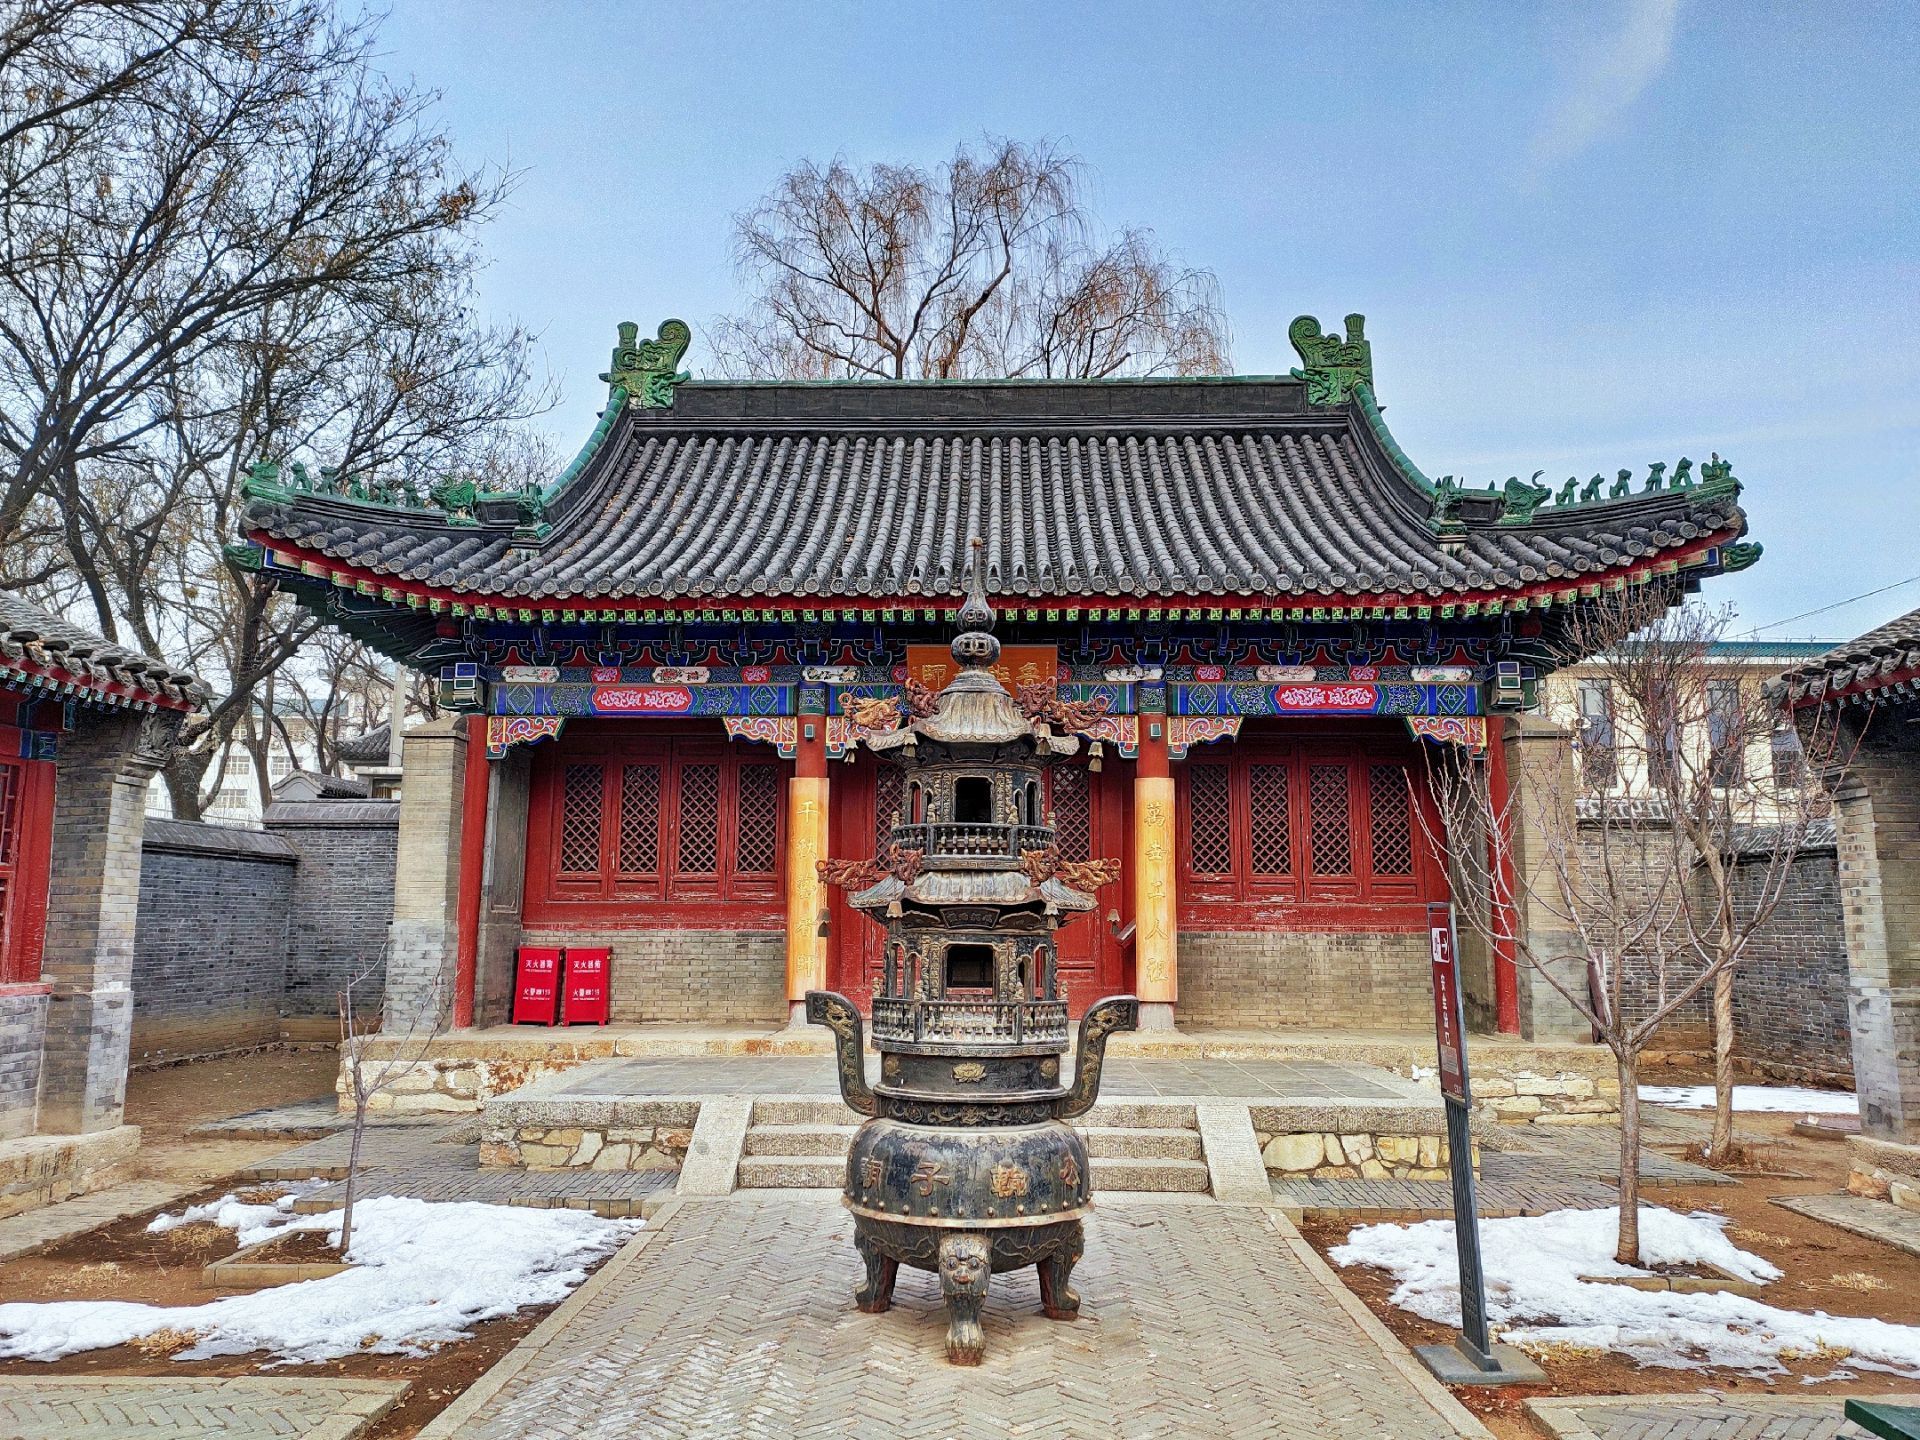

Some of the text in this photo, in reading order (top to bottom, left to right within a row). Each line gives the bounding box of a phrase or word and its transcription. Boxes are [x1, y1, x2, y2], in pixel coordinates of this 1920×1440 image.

[525, 959, 553, 969] 灭火器箱
[573, 960, 601, 969] 灭火器箱
